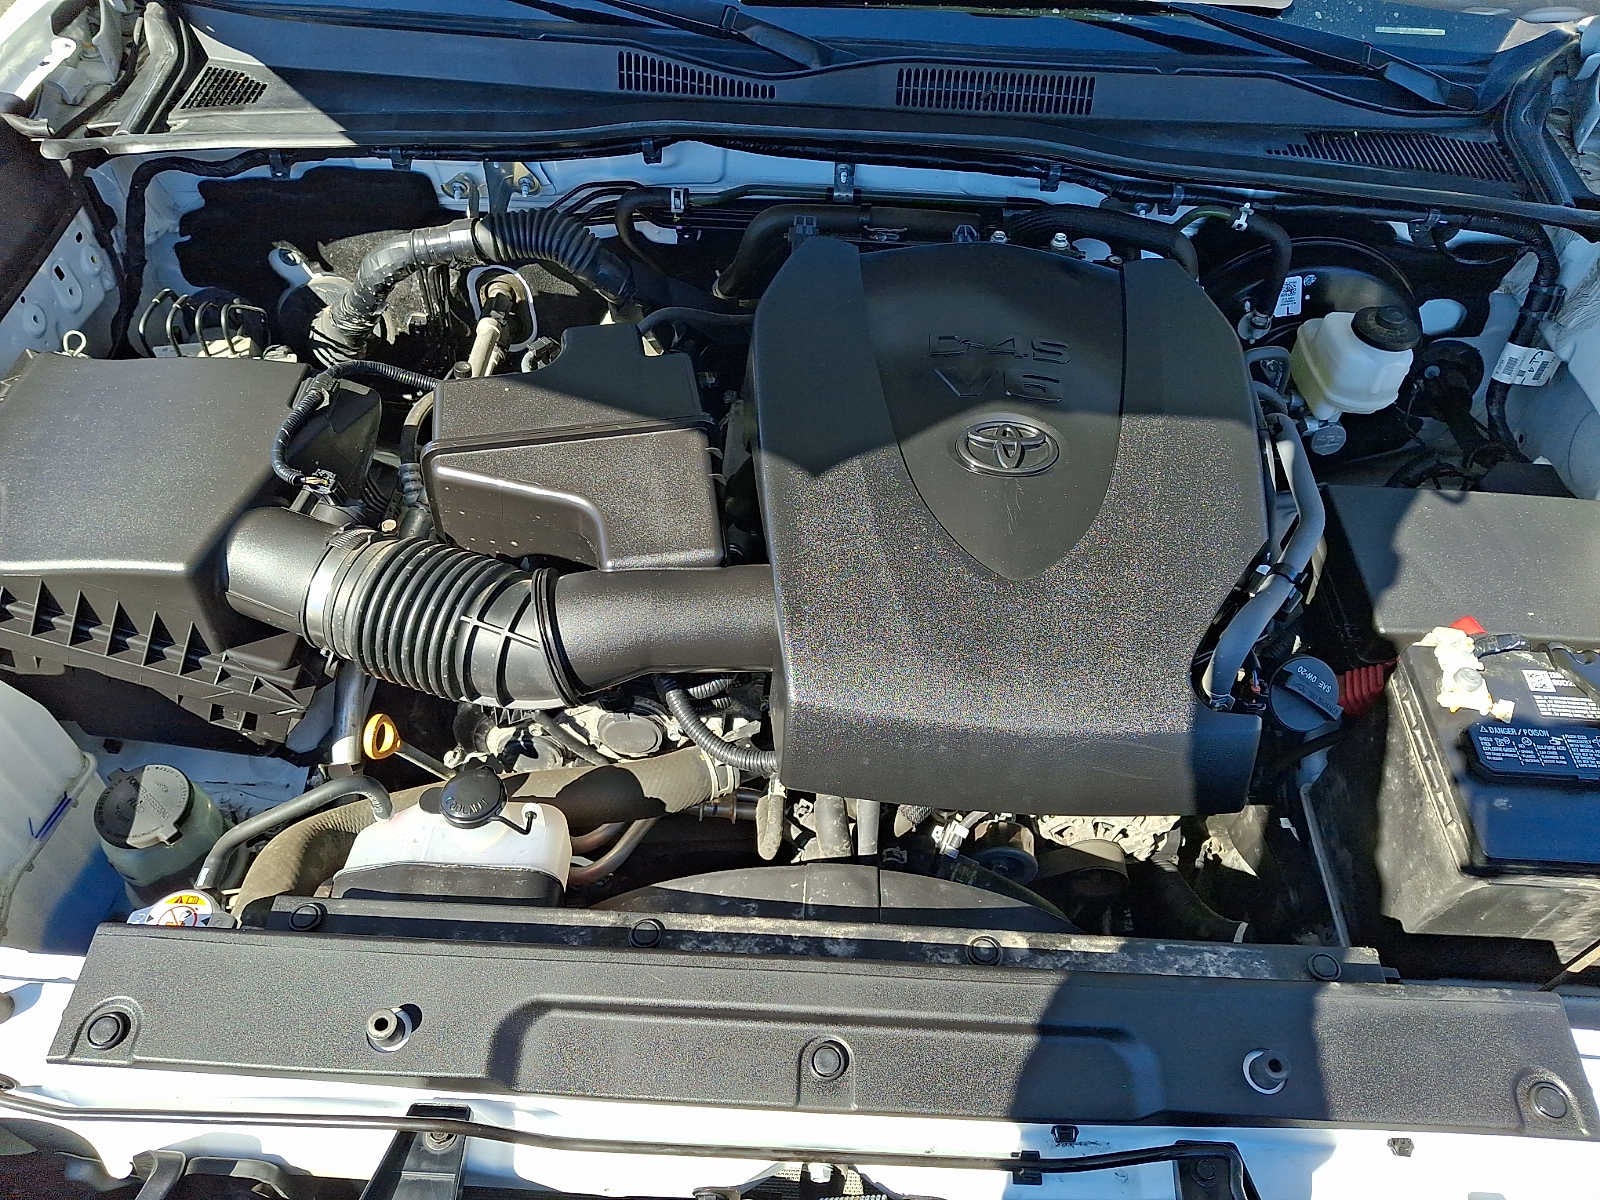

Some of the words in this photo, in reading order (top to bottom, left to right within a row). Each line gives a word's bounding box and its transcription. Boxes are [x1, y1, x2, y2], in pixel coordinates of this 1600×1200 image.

[1297, 665, 1317, 683] 0W-20
[1318, 680, 1332, 693] SAE
[1487, 726, 1518, 736] DANGER
[1522, 728, 1550, 738] POISON
